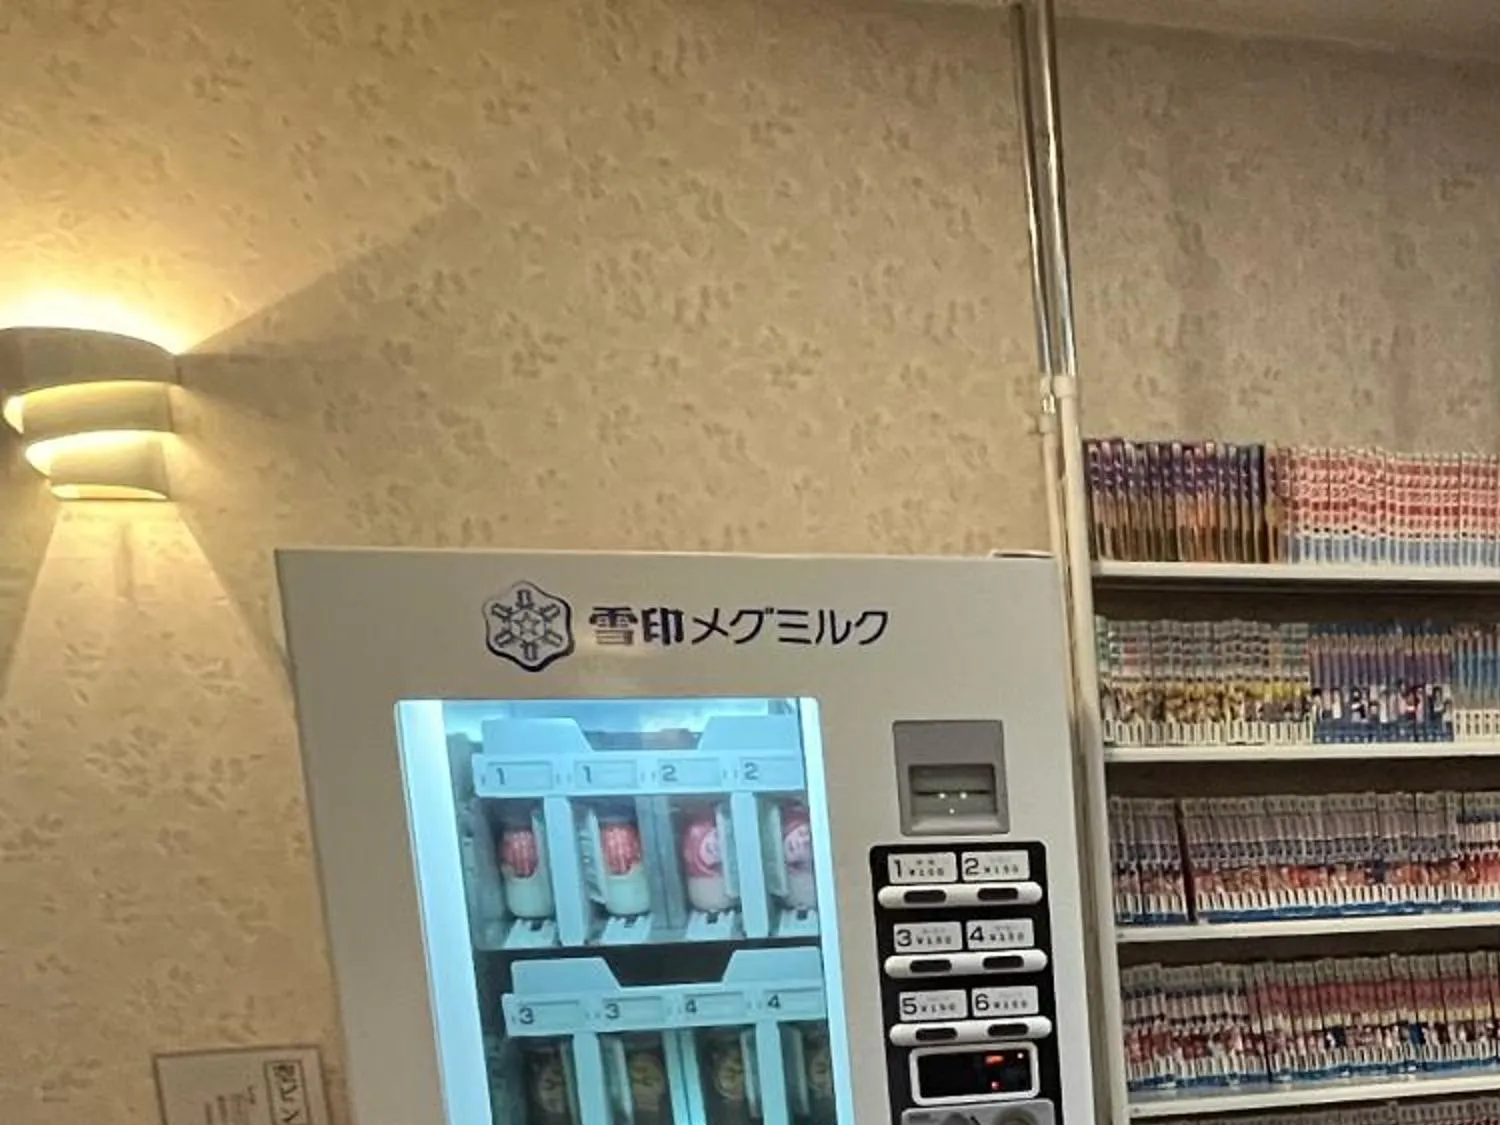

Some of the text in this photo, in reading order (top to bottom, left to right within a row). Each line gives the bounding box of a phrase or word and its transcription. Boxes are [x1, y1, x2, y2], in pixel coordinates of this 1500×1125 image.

[588, 605, 891, 648] 雪印メグミルク
[496, 767, 506, 785] 1
[582, 766, 593, 784] 1
[662, 764, 678, 782] 2
[744, 762, 760, 781] 2
[893, 859, 903, 878] 1
[964, 857, 979, 876] 2
[896, 928, 912, 946] 3
[969, 925, 985, 943] 4
[684, 998, 699, 1015] 4
[766, 993, 782, 1010] 4
[901, 996, 917, 1015] 5
[974, 993, 989, 1011] 6
[518, 1006, 535, 1025] 3
[604, 1002, 621, 1020] 3
